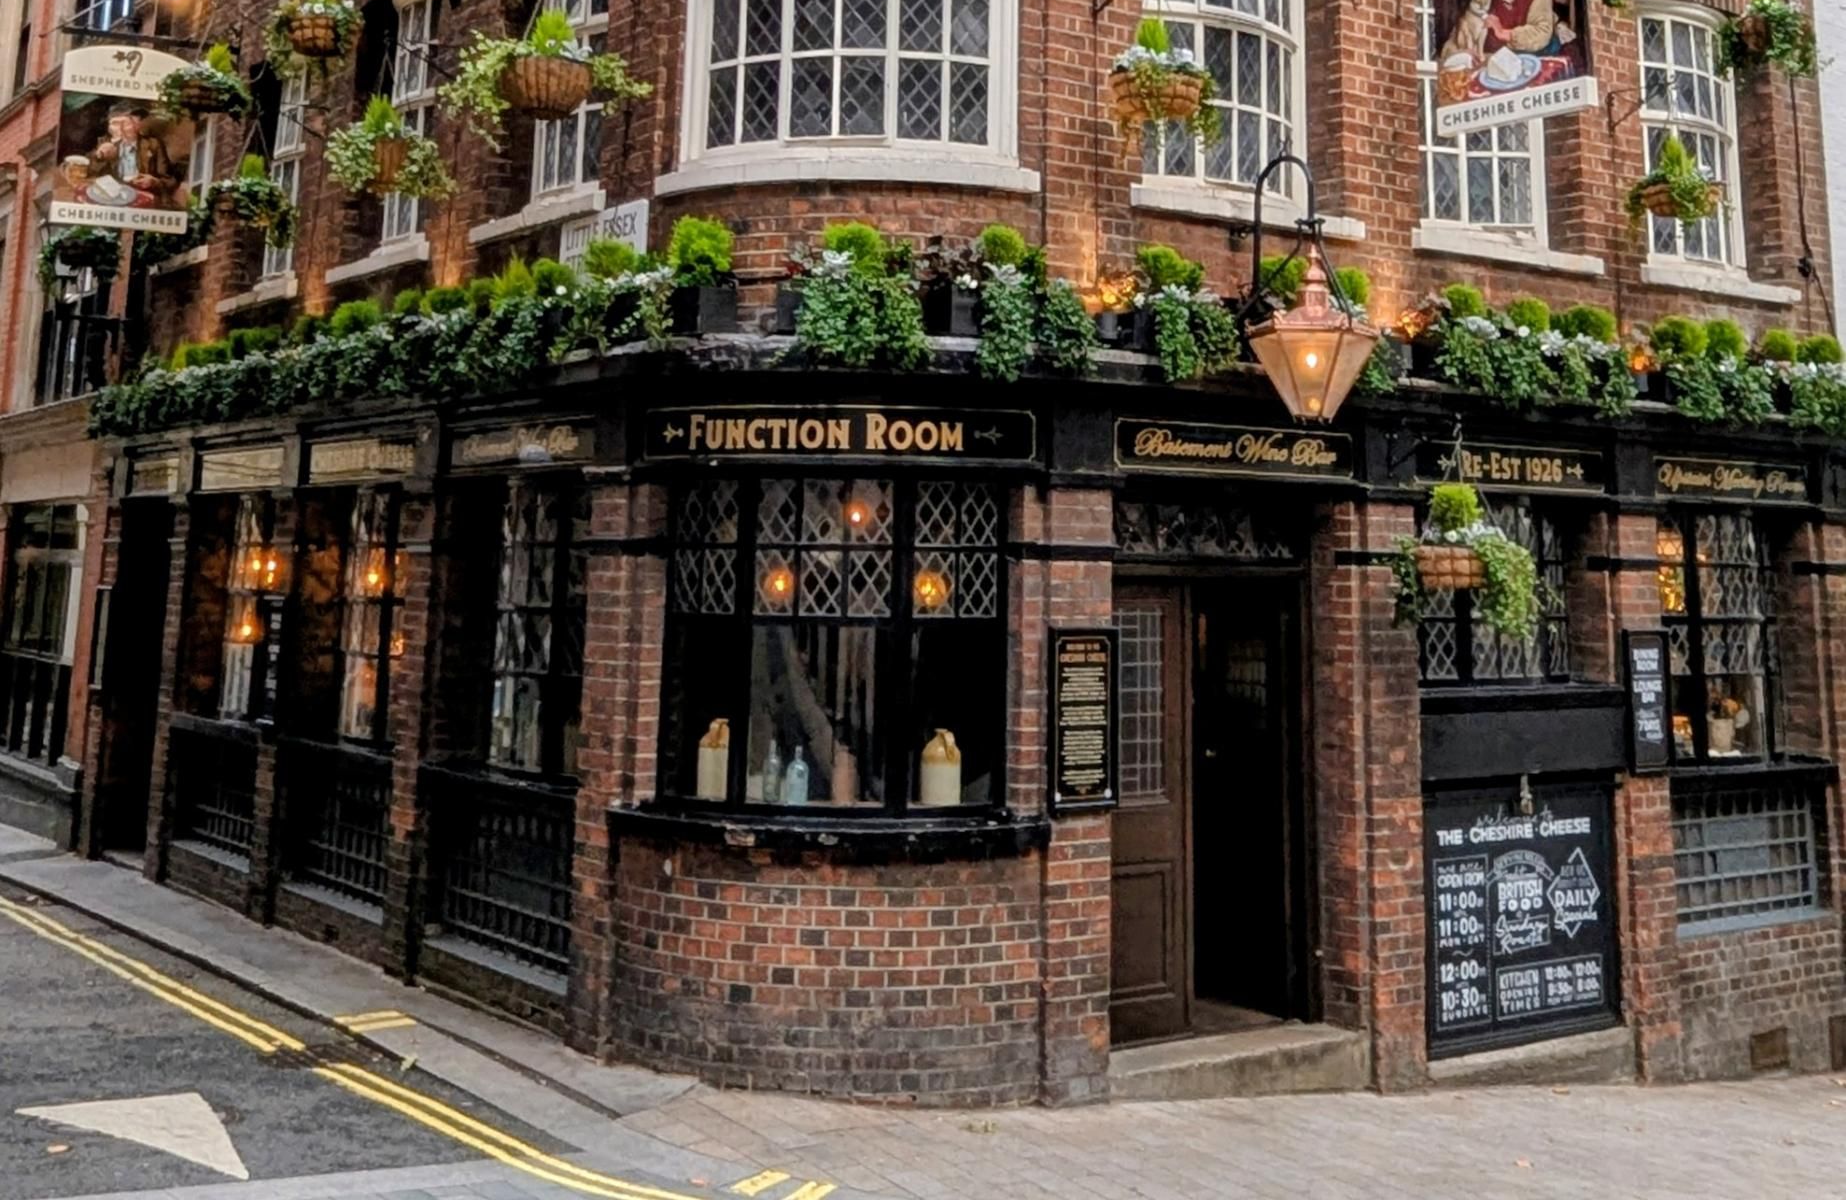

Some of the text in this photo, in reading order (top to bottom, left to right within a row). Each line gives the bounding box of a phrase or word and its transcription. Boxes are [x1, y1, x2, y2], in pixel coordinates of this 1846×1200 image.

[70, 74, 141, 90] SHEPHERD
[1442, 86, 1581, 127] CHESHIRE CHEESE
[57, 208, 182, 227] CHESHIRE CHEESE
[688, 412, 965, 452] FUNCTION ROOM
[1134, 428, 1337, 466] Basement Wine Bar
[1461, 451, 1563, 483] RE-EST 1926
[1658, 463, 1712, 492] Upstairs
[1766, 471, 1806, 494] Room
[1436, 817, 1591, 847] THE CHESHIRE CHEESE
[1498, 879, 1543, 901] BRITISH
[1498, 897, 1543, 913] FOOD
[1554, 887, 1598, 908] DAILY
